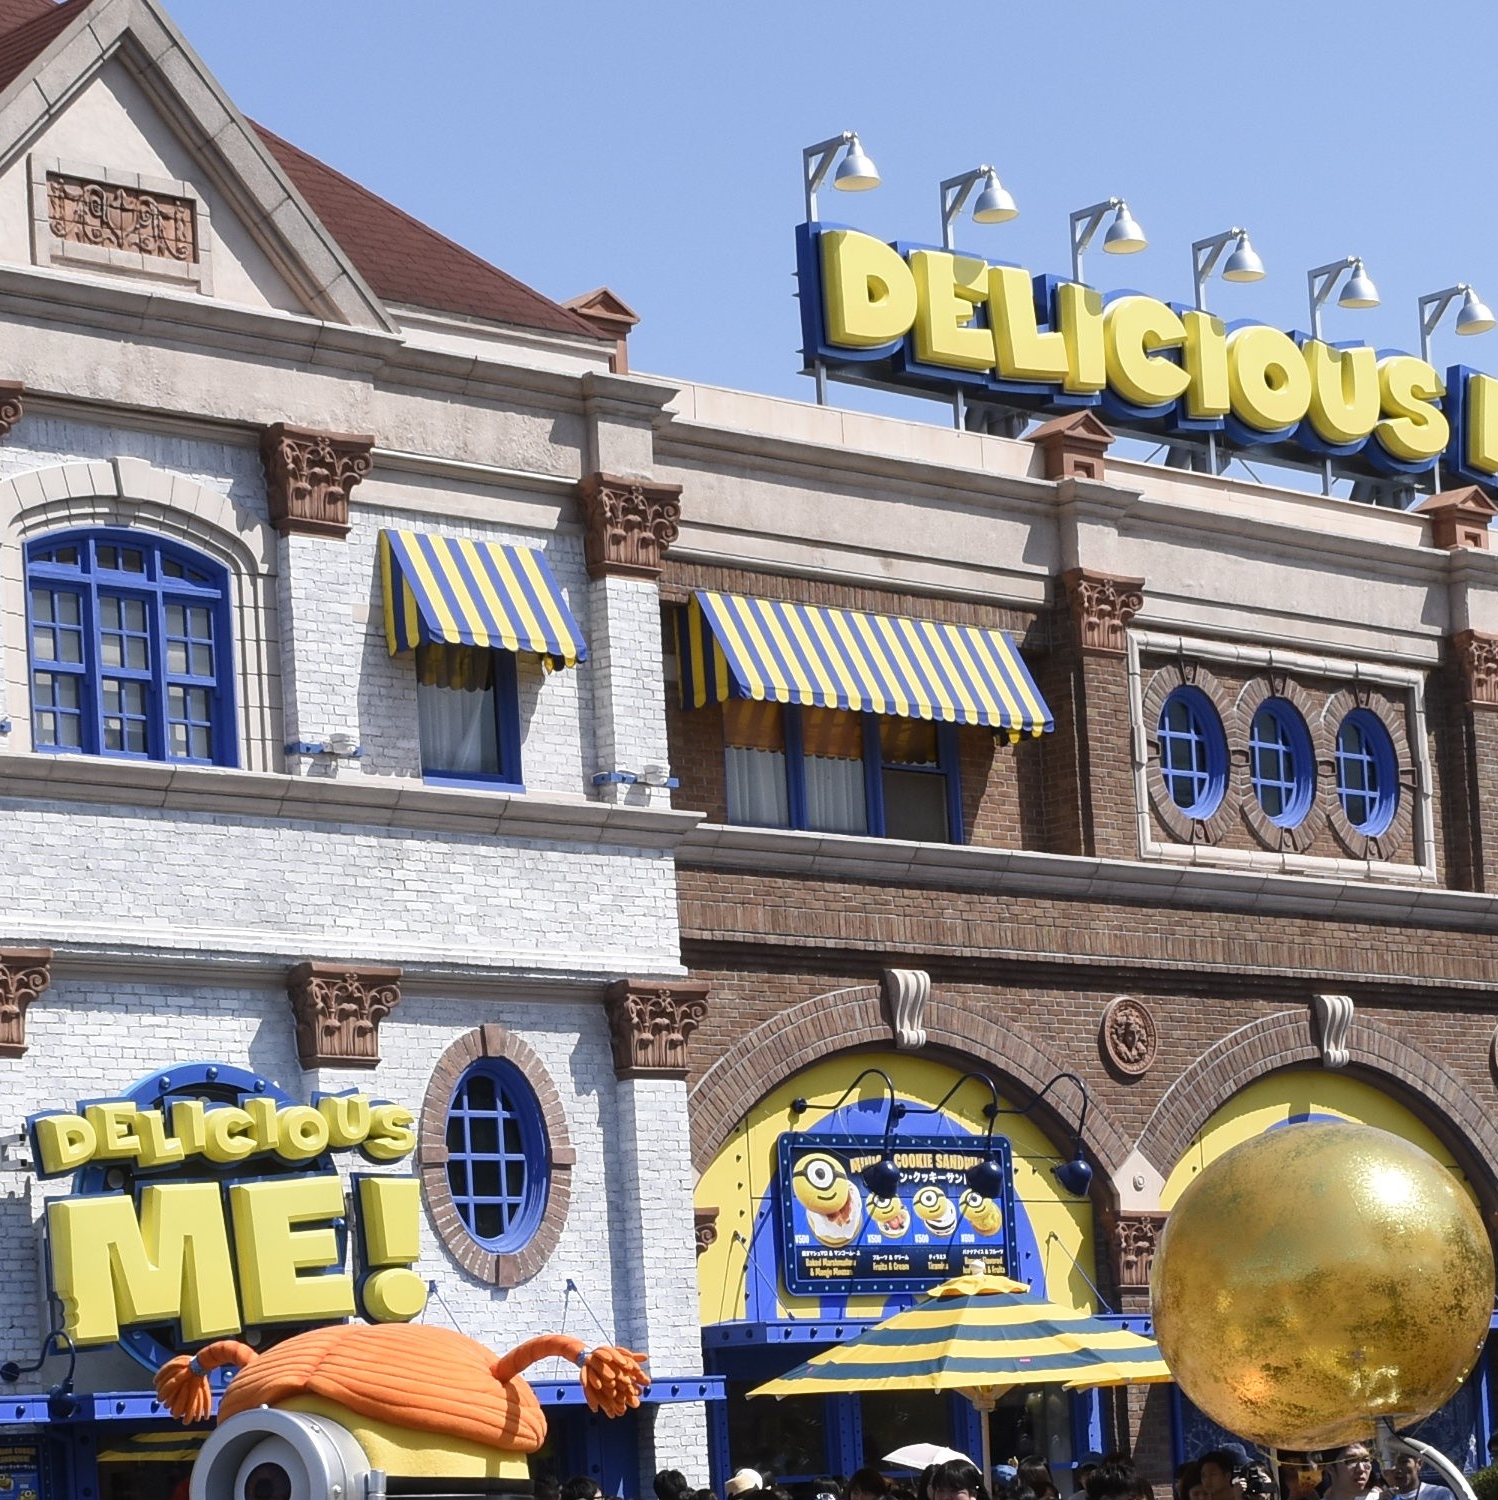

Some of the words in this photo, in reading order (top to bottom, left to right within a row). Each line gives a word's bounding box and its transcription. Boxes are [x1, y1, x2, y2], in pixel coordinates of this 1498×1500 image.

[820, 230, 1449, 463] DELICIOUS
[37, 1093, 416, 1174] DELICIOUS
[894, 1154, 933, 1168] COOKIE
[47, 1175, 427, 1349] ME!
